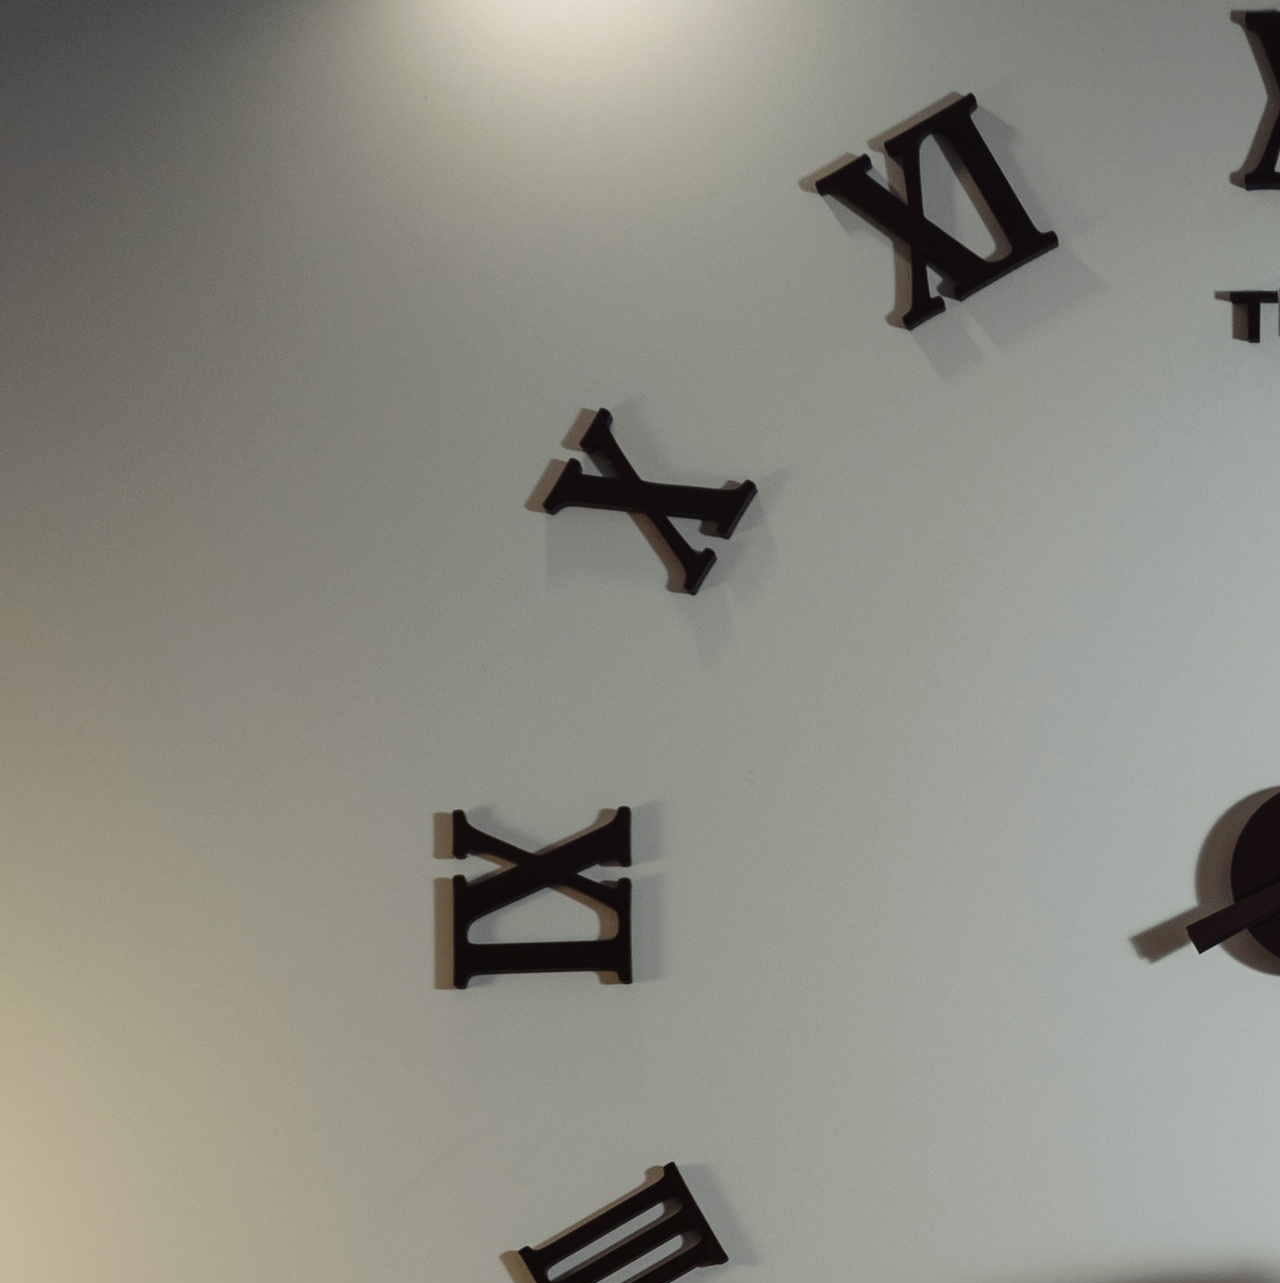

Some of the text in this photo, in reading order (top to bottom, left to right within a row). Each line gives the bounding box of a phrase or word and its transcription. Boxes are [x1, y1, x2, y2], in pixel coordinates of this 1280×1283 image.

[815, 93, 1058, 330] XI
[543, 408, 757, 595] X
[452, 806, 633, 990] IX
